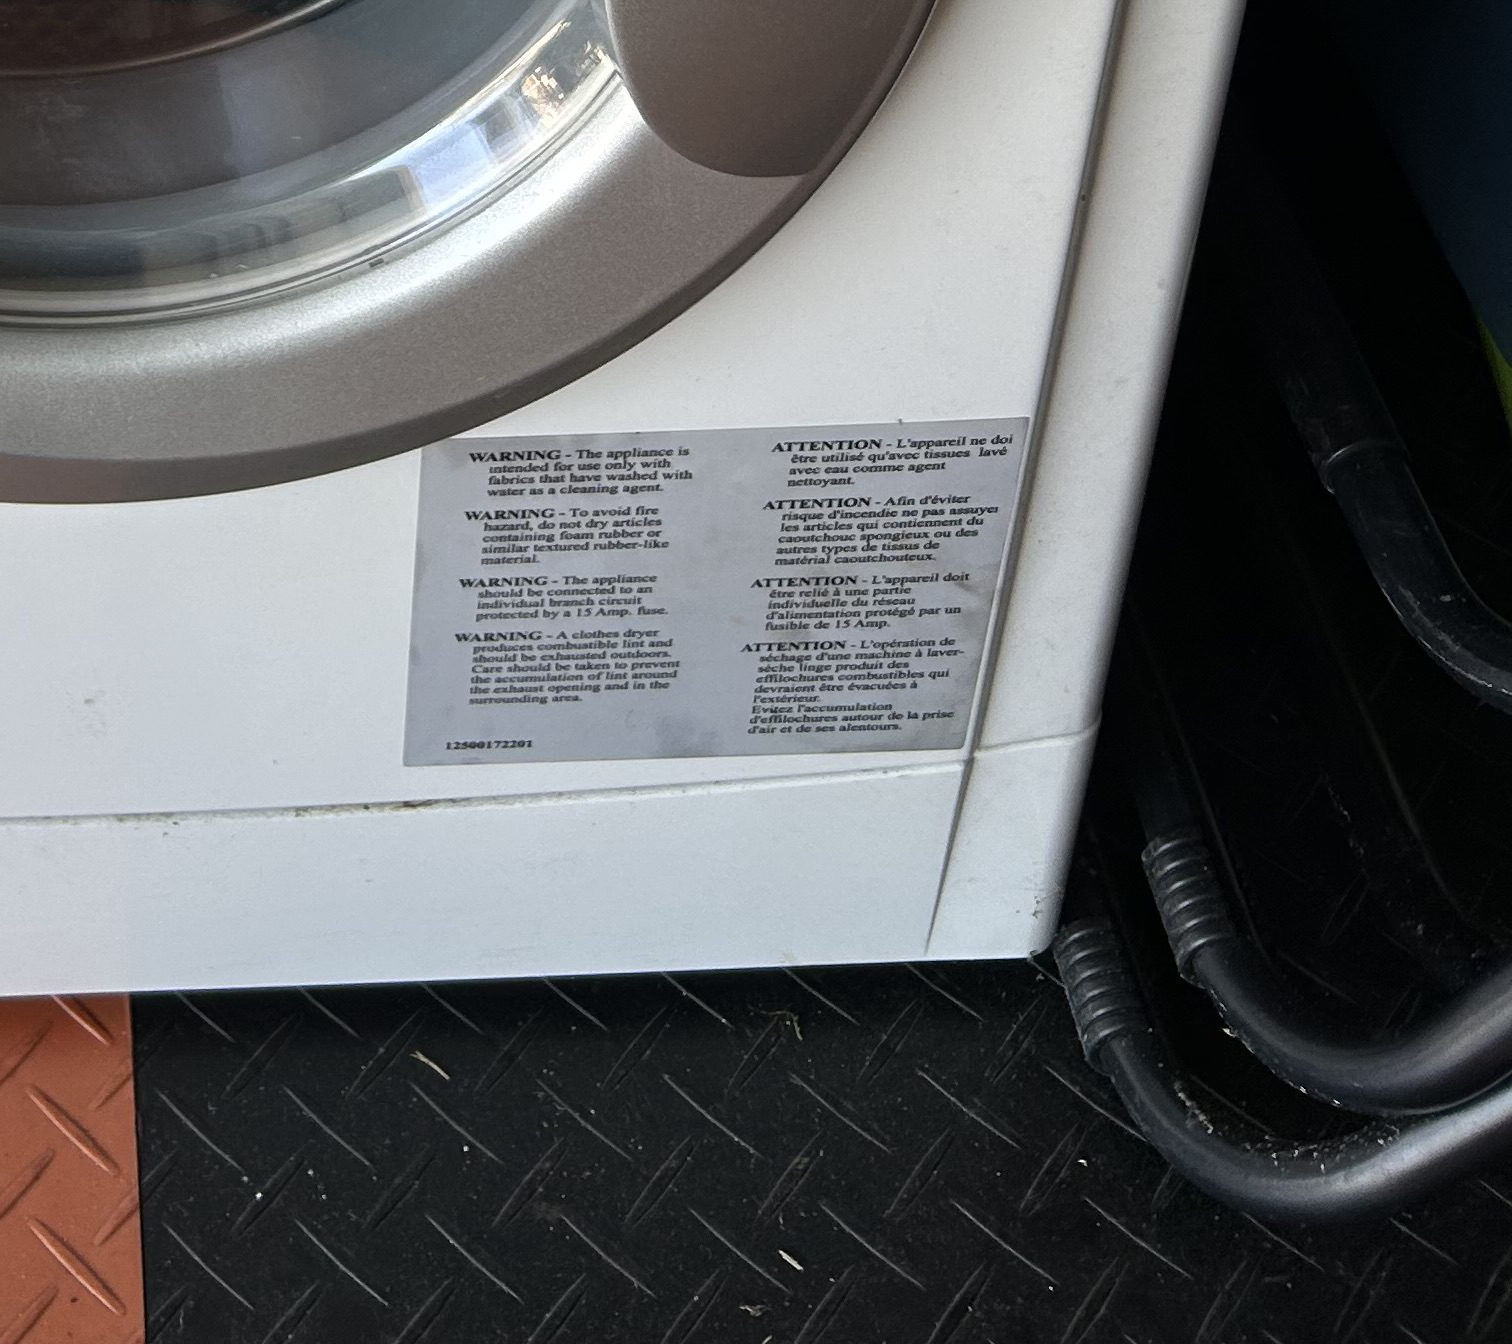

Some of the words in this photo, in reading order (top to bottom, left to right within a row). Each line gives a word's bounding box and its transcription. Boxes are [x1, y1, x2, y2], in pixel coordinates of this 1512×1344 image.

[772, 439, 883, 452] ATTENTION
[469, 450, 561, 462] WARNING
[762, 496, 872, 510] ATTENTION
[464, 508, 555, 521] WARNING
[459, 575, 548, 588] WARNING
